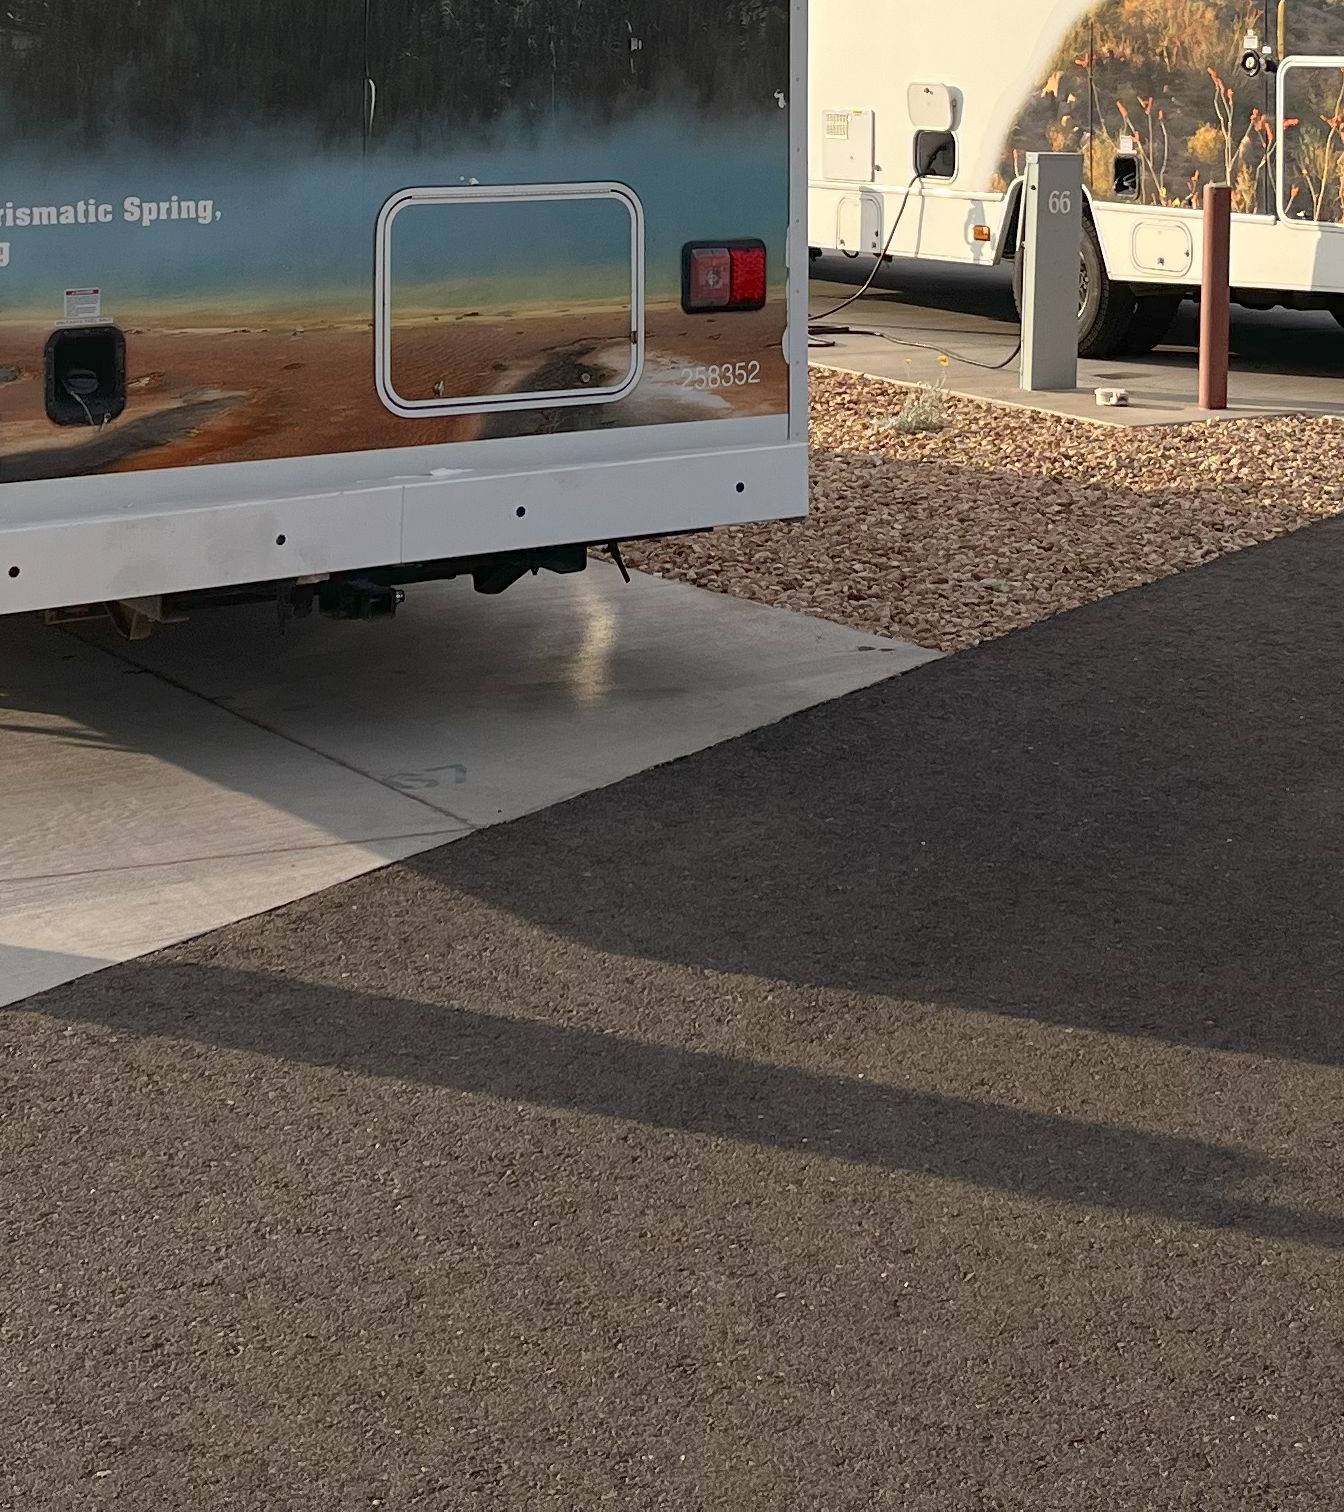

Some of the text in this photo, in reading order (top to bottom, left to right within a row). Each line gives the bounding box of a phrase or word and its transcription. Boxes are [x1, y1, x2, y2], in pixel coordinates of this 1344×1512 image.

[123, 195, 222, 227] Spring,
[1048, 190, 1072, 215] 66
[680, 360, 761, 390] 258352
